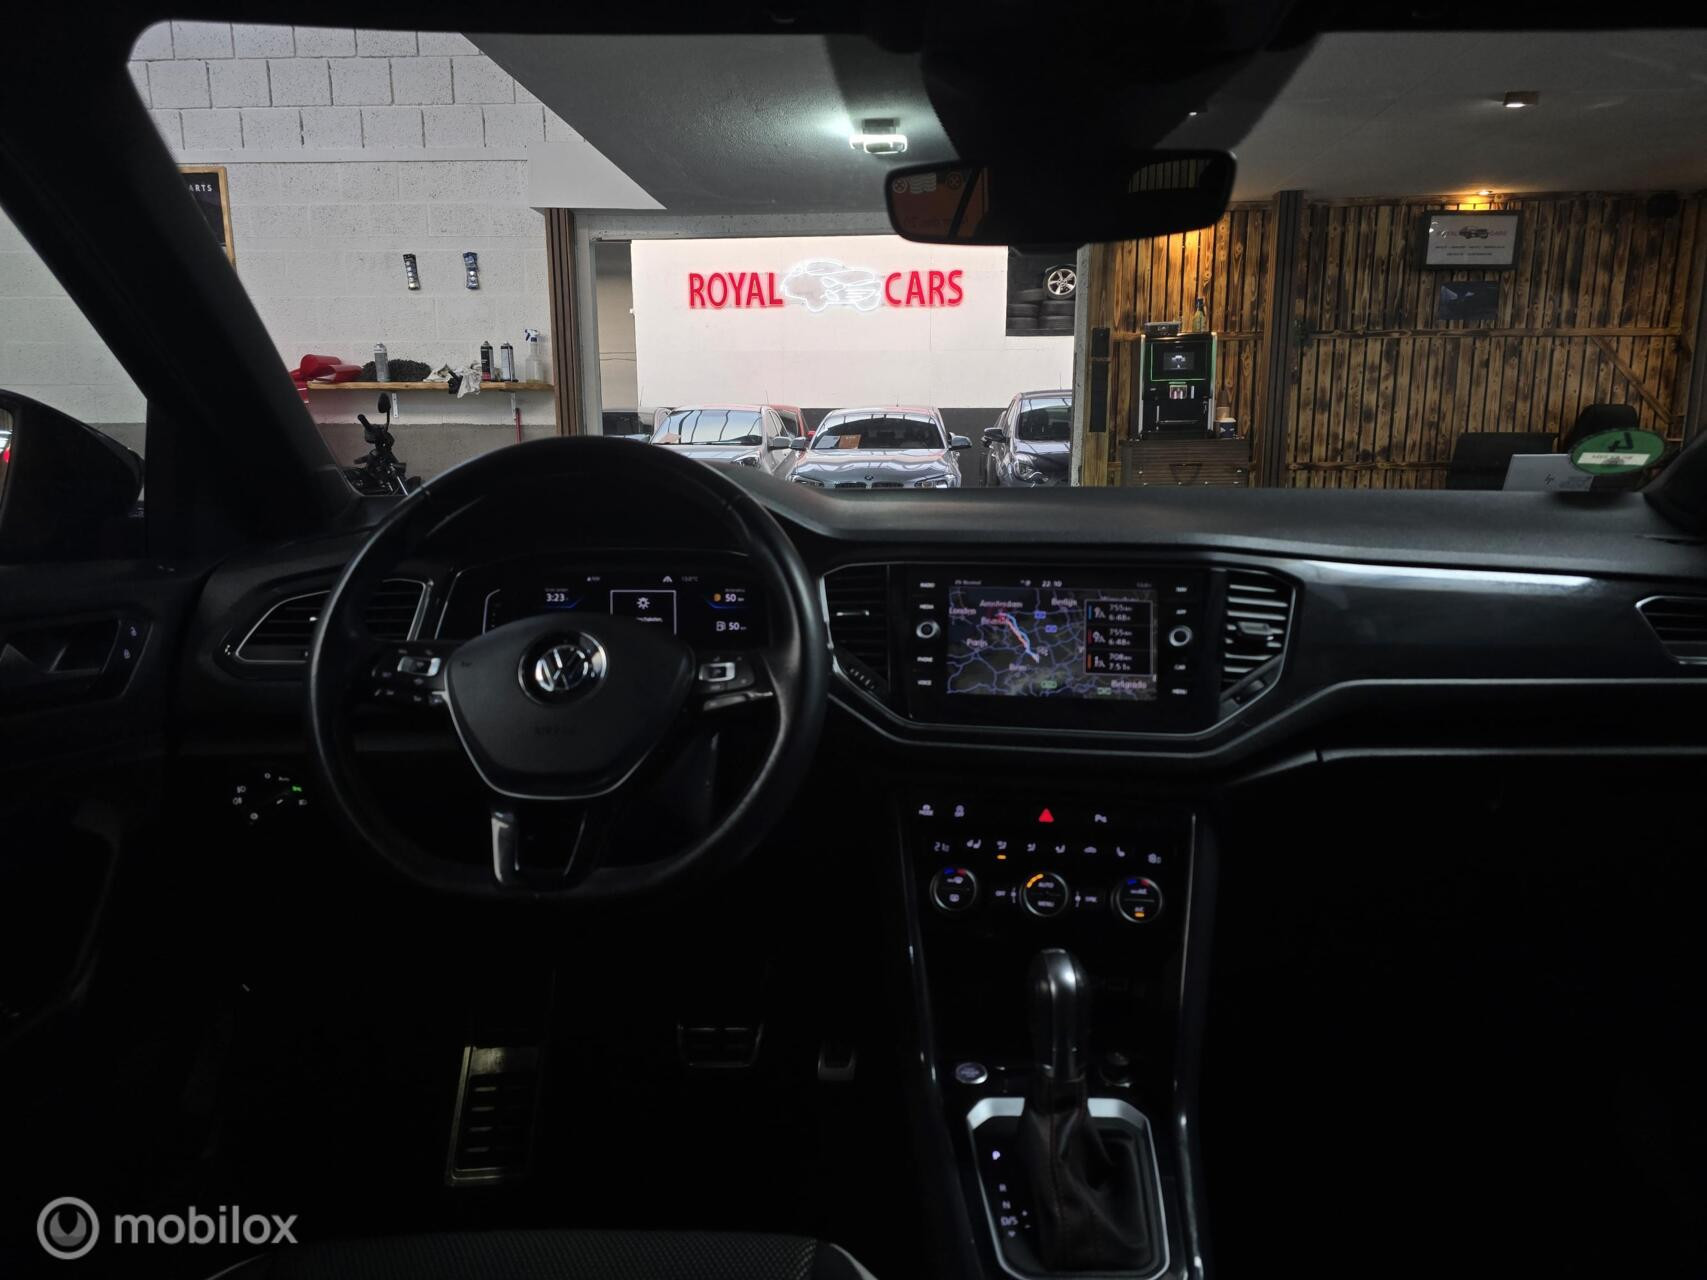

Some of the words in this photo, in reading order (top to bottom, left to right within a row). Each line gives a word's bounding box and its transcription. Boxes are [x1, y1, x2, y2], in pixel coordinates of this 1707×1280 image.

[688, 271, 784, 309] ROYAL
[884, 269, 964, 307] CARS
[545, 593, 565, 602] 3:23
[724, 593, 737, 602] 50
[728, 622, 740, 631] 50
